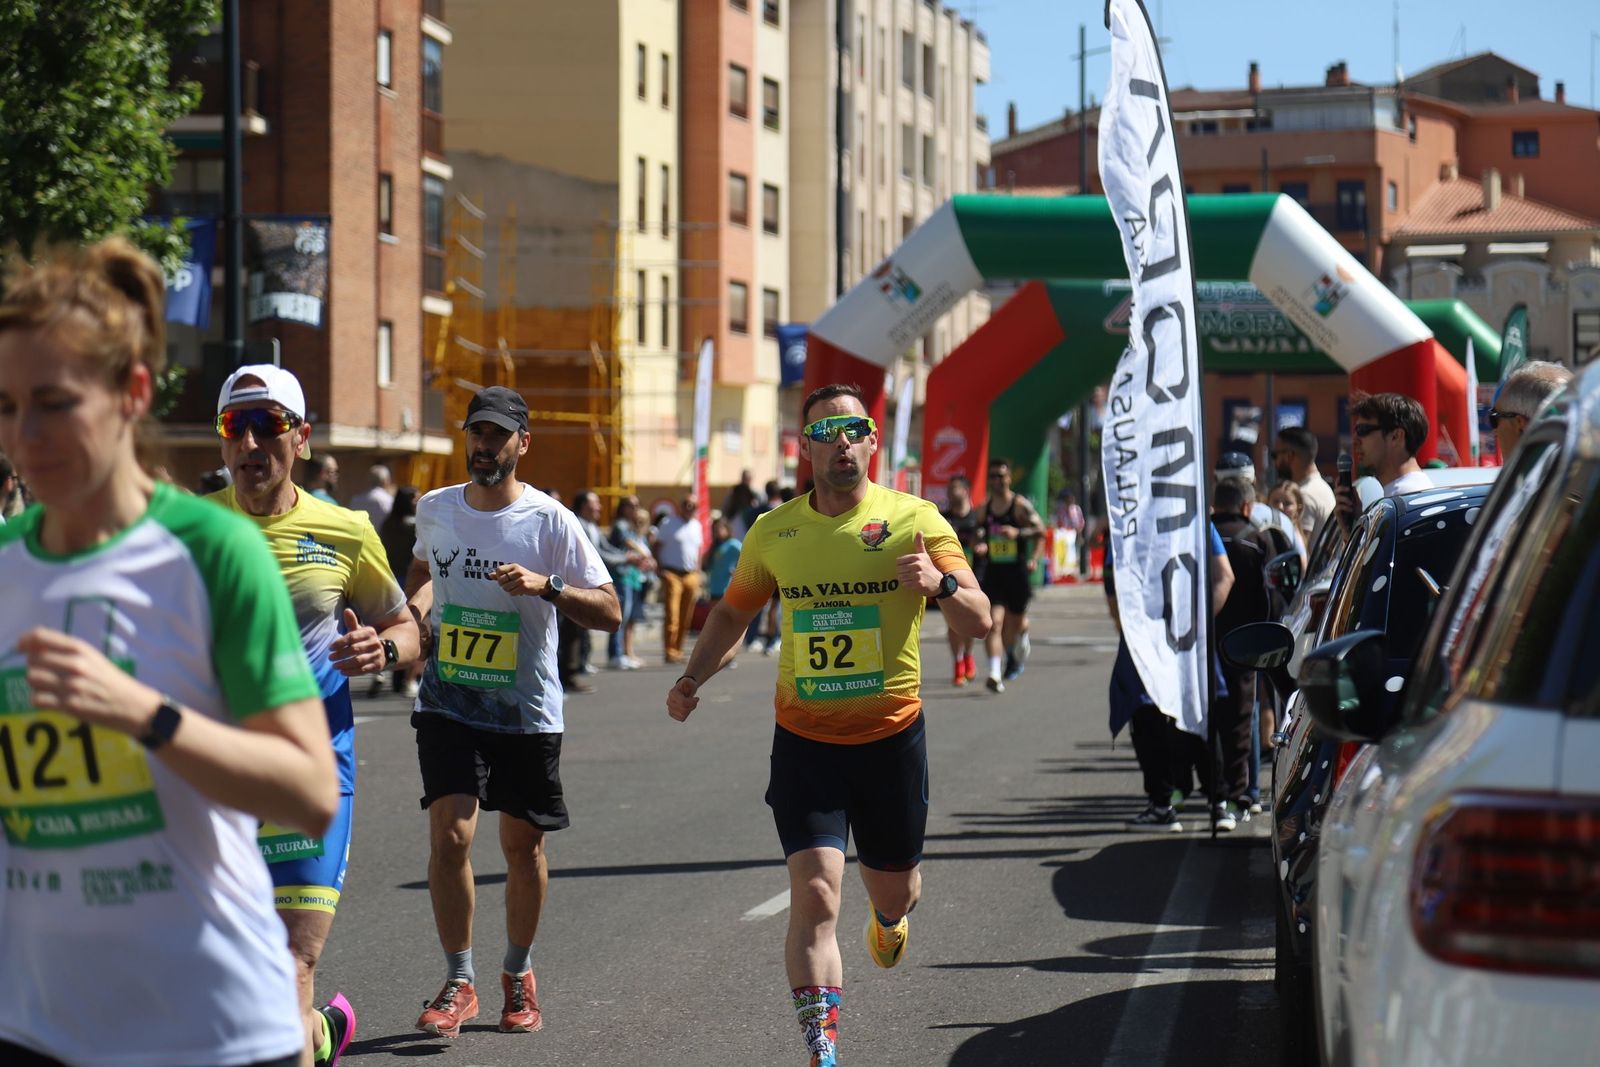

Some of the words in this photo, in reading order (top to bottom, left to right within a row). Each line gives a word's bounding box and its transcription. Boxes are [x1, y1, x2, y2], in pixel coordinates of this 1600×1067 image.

[466, 548, 477, 557] XI
[816, 579, 899, 597] VALORIO
[813, 600, 852, 609] ZAMORA
[812, 619, 828, 627] CAJA
[830, 618, 854, 626] RURAL
[446, 628, 502, 663] 177
[808, 634, 855, 671] 52
[458, 669, 479, 680] CAJA
[480, 672, 511, 683] RURAL
[818, 682, 842, 692] CAJA
[845, 679, 880, 690] RURAL
[0, 719, 100, 791] 121
[35, 814, 77, 836] CAJA
[79, 804, 145, 830] RURAL
[275, 839, 319, 854] RURAL
